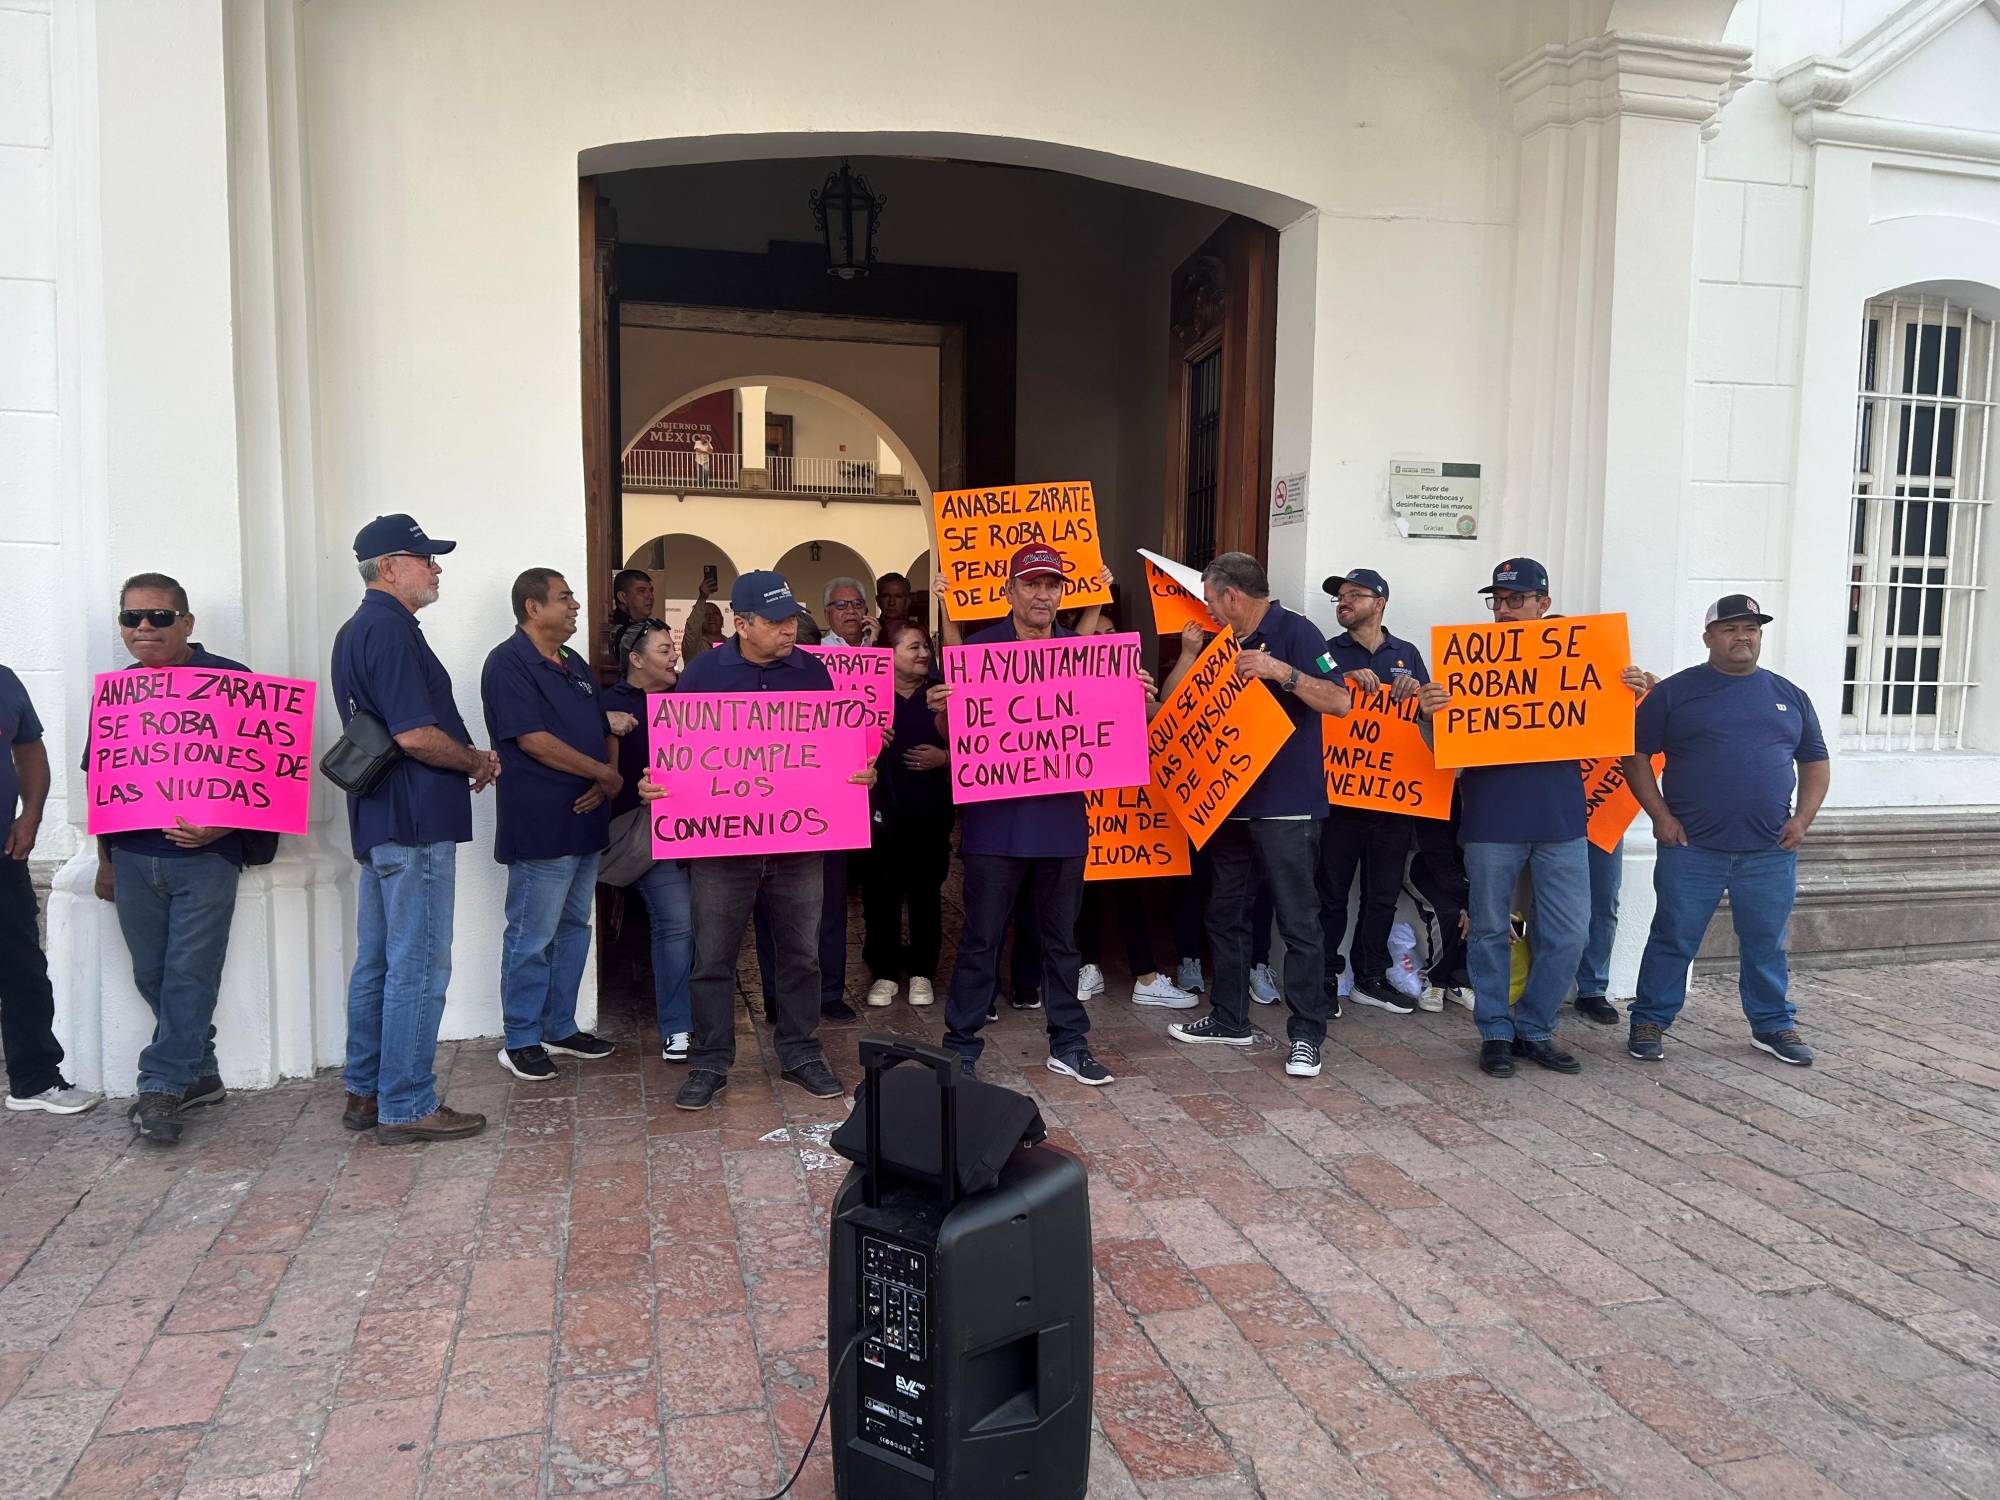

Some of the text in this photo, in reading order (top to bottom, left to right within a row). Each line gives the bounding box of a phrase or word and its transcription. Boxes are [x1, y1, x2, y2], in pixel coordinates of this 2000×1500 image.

[700, 424, 712, 432] DE
[941, 486, 1091, 519] ANABEL ZARATE
[944, 518, 1092, 552] SE ROBA LAS
[1423, 524, 1444, 532] Gracias
[953, 588, 982, 606] DE
[1443, 625, 1586, 665] AQUI SE
[950, 644, 1142, 684] H. AYUNTAMIENTO
[1176, 685, 1198, 719] SE
[1192, 633, 1239, 696] ROBAN
[1448, 663, 1602, 698] ROBAN LA
[97, 672, 305, 714] ANABEL ZARATE
[965, 690, 1080, 728] DE CLN.
[98, 710, 295, 746] SE ROBA LAS
[653, 699, 866, 737] AYUNTAMIENTO
[1349, 719, 1380, 743] NO
[1448, 700, 1586, 734] PENSION
[957, 721, 1115, 755] NO CUMPLE
[97, 742, 308, 781] PENSIONES DE
[656, 743, 821, 772] NO CUMPLE
[958, 752, 1093, 788] CONVENIO
[1155, 753, 1182, 789] LAS
[1175, 725, 1240, 804] DE LAS
[96, 777, 270, 808] LAS VIUDAS
[712, 776, 774, 797] LOS
[1118, 786, 1152, 809] LA
[1188, 753, 1252, 826] VIUDAS
[654, 808, 828, 842] CONVENIOS
[1135, 812, 1170, 830] DE
[1090, 843, 1172, 865] IUDAS
